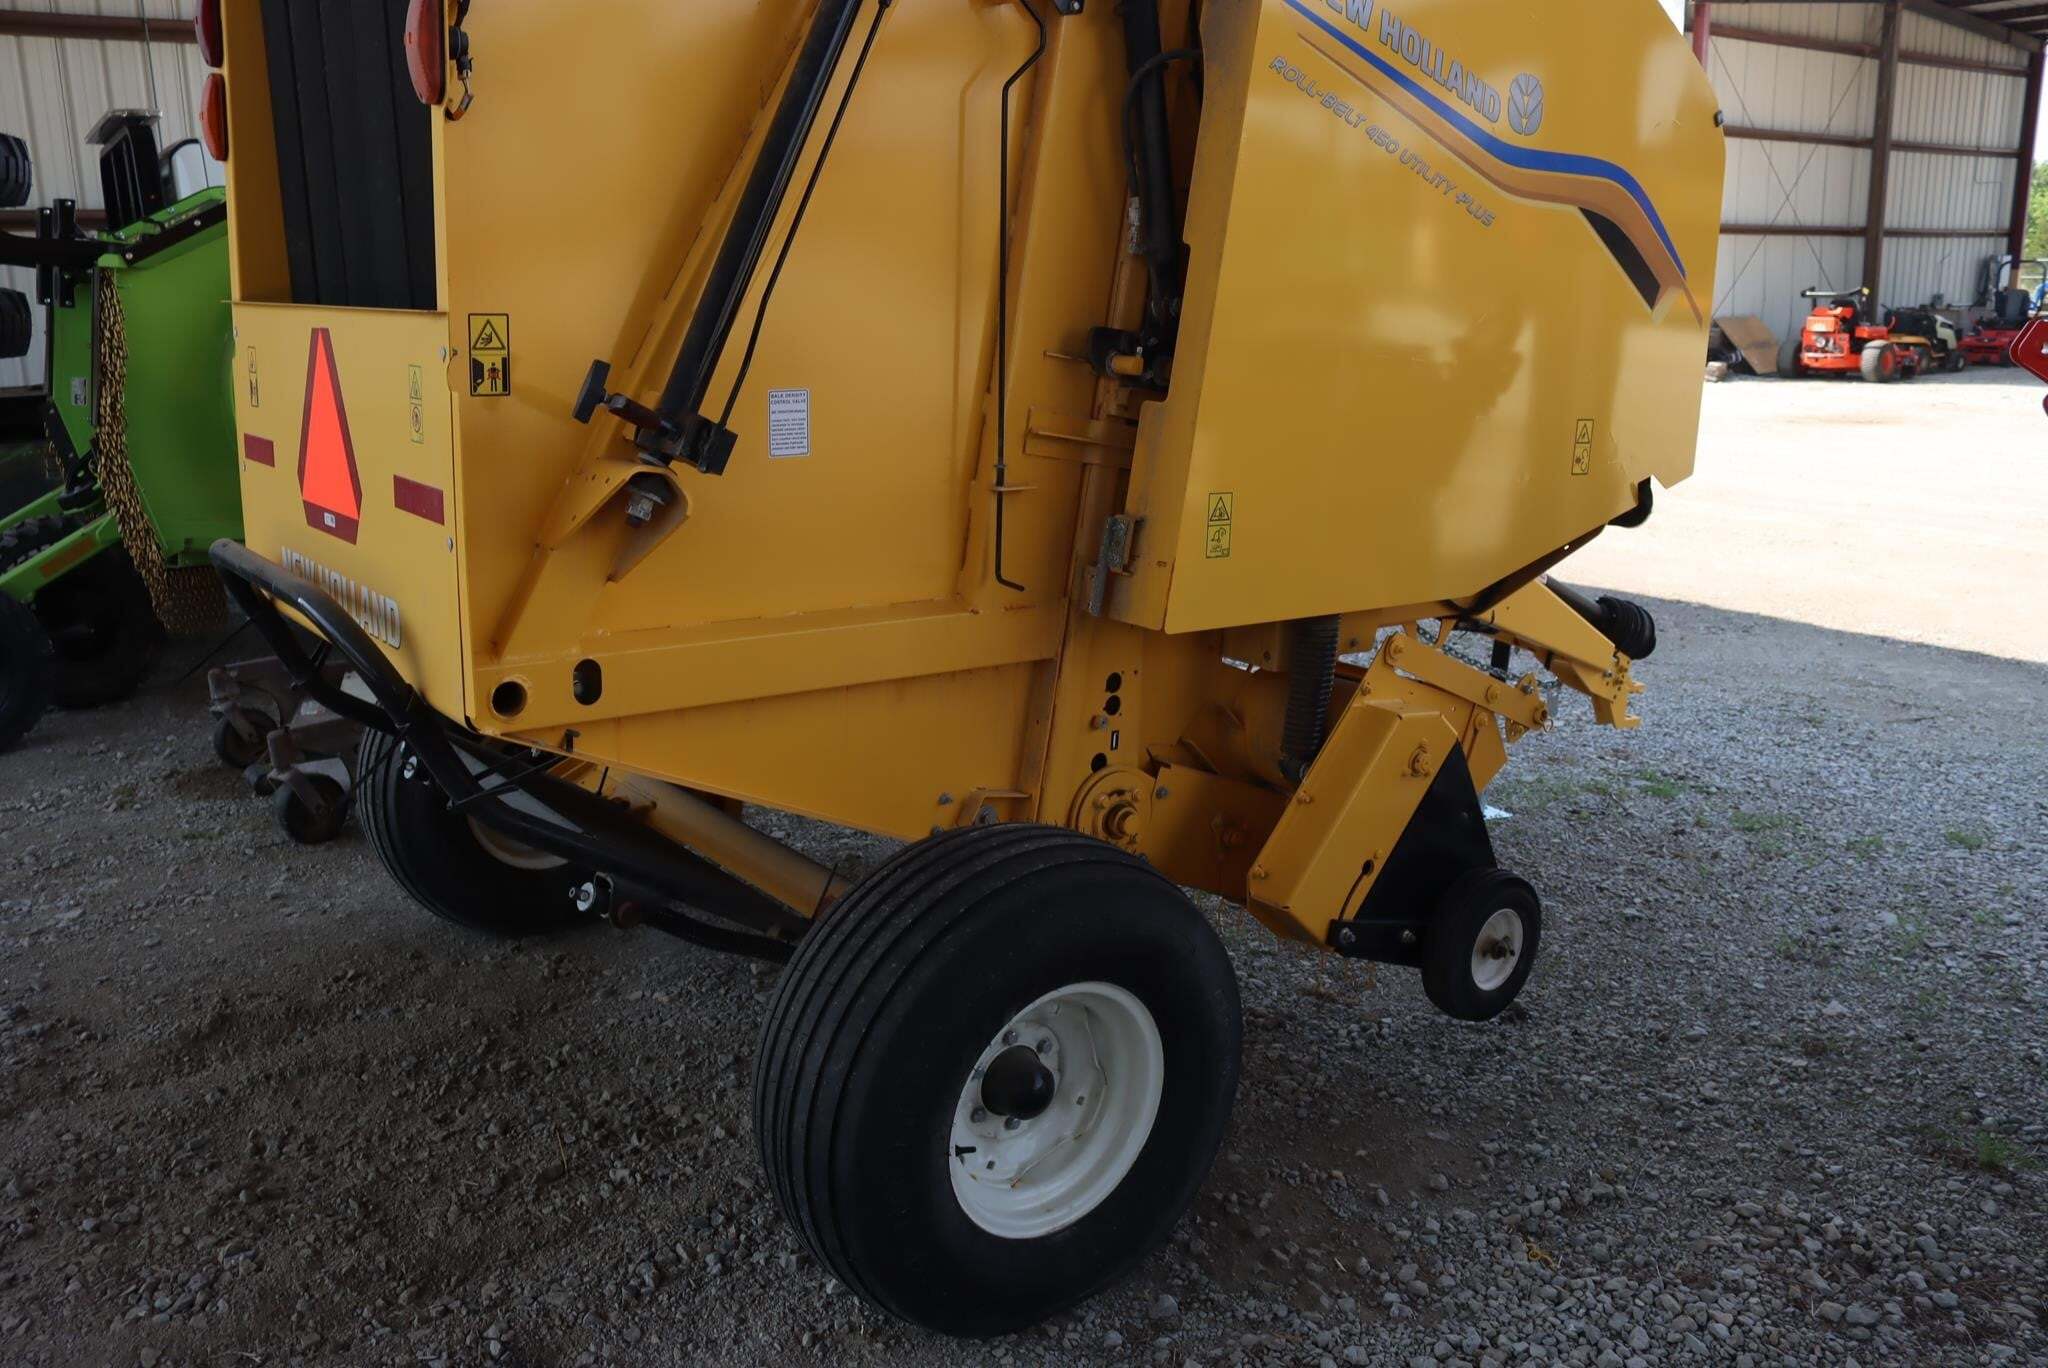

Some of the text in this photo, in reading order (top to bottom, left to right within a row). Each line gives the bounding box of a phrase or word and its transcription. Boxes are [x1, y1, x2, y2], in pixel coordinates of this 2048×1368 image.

[1378, 8, 1501, 124] HOLLAND
[1269, 55, 1497, 227] ROLL-BELT 450 UTILITY PLUS
